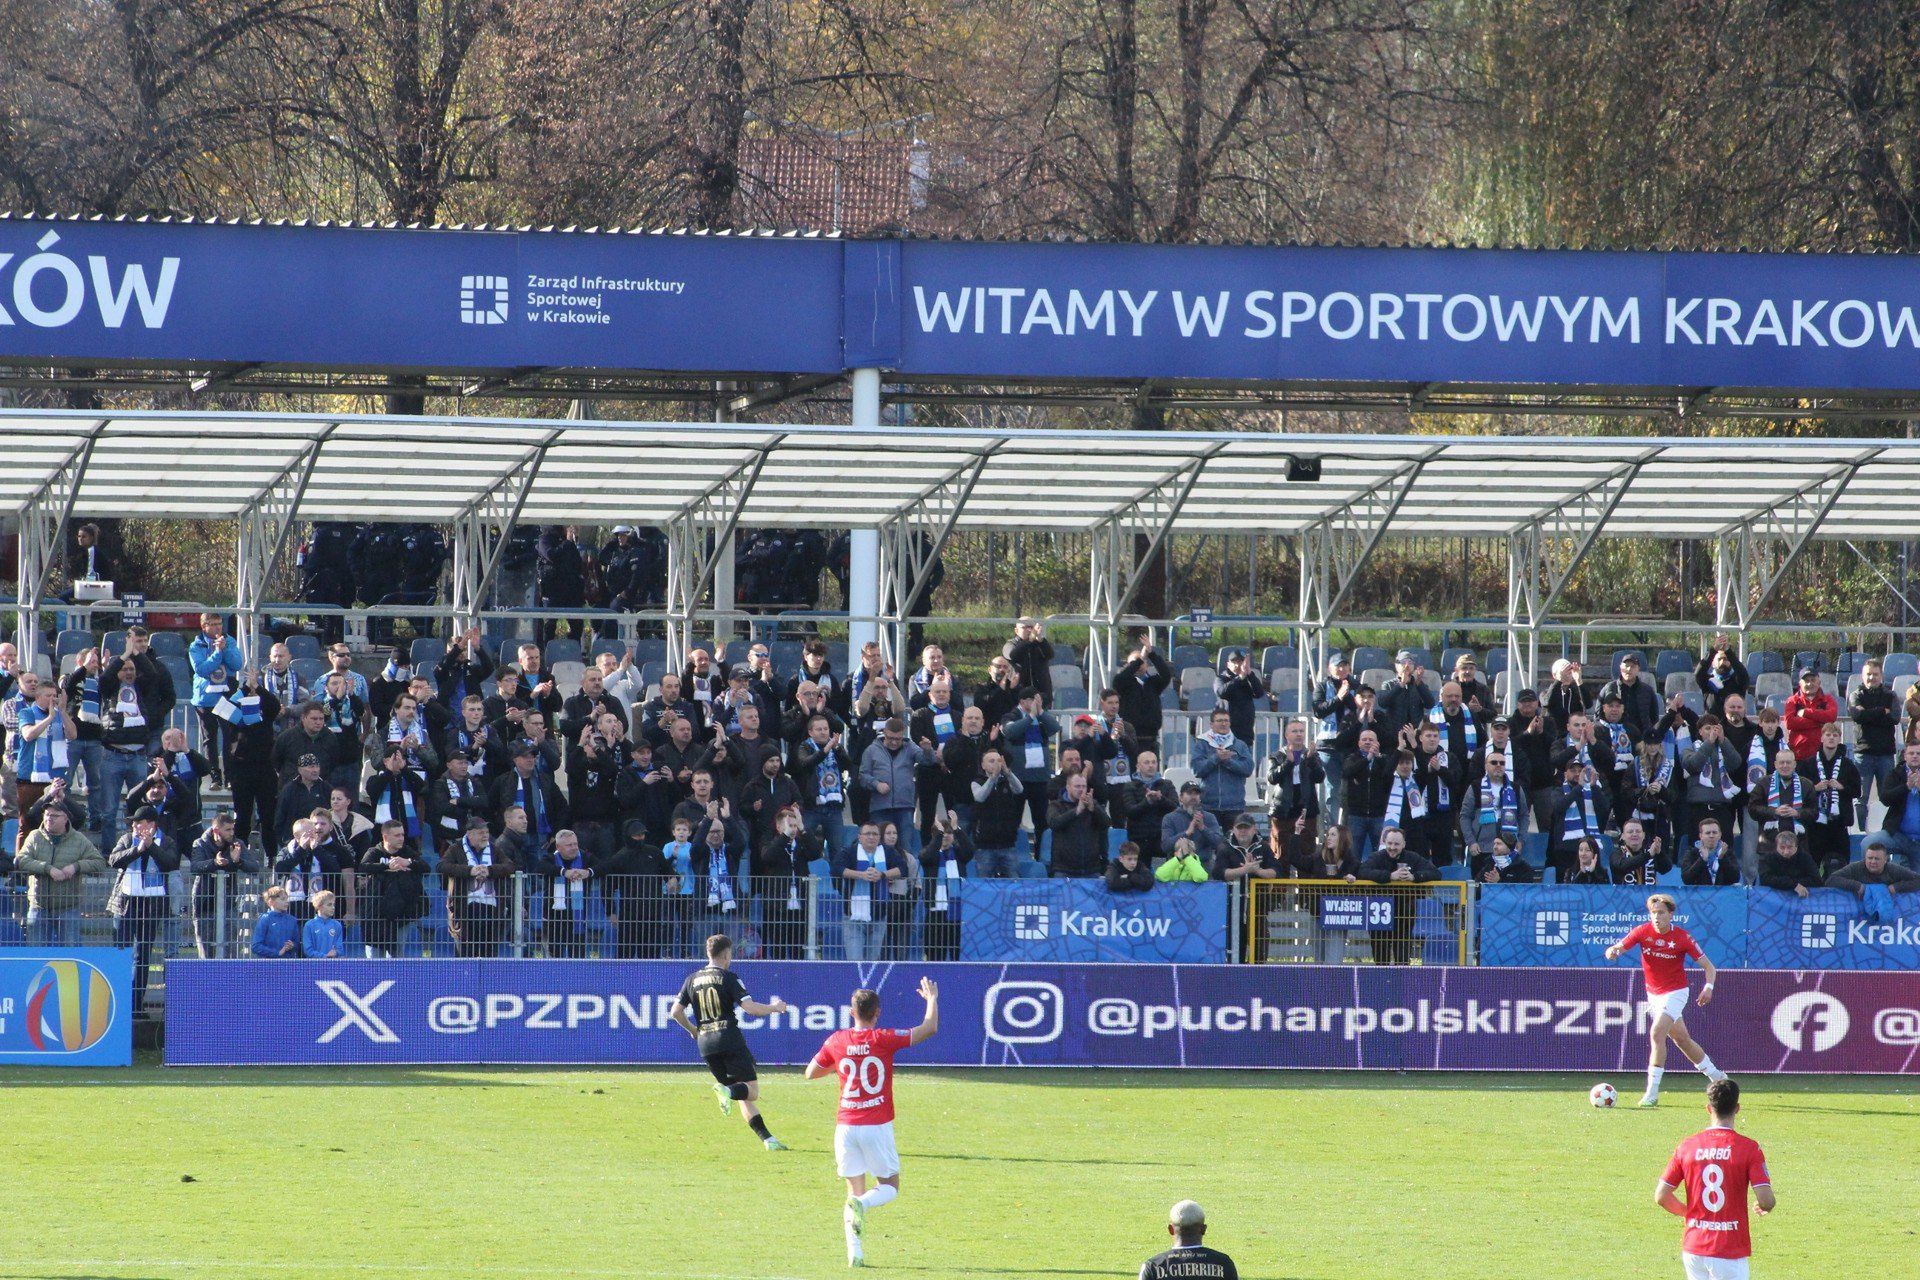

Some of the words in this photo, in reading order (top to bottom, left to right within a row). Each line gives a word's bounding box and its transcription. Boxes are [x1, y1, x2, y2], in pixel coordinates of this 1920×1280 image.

[527, 275, 577, 291] Zarząd
[582, 277, 685, 294] Infrastruktury
[527, 293, 602, 309] Sportowej
[527, 312, 538, 322] w
[543, 311, 611, 324] Krakowie
[913, 286, 1158, 337] WITAMY
[1172, 290, 1230, 337] W
[1244, 290, 1640, 343] SPORTOWYM
[1061, 909, 1171, 937] Kraków
[1324, 915, 1363, 925] AWARYJNE
[1325, 899, 1362, 912] WYJŚCIE
[1369, 902, 1392, 925] 33
[1582, 913, 1615, 923] Zarząd
[428, 994, 852, 1034] @PZPNPchar
[696, 988, 720, 1021] 10
[839, 1056, 885, 1098] 20
[1695, 1146, 1732, 1161] CARBÓ
[1702, 1164, 1725, 1213] 8
[1155, 1265, 1168, 1280] D.
[1169, 1263, 1225, 1278] GUERRIER
